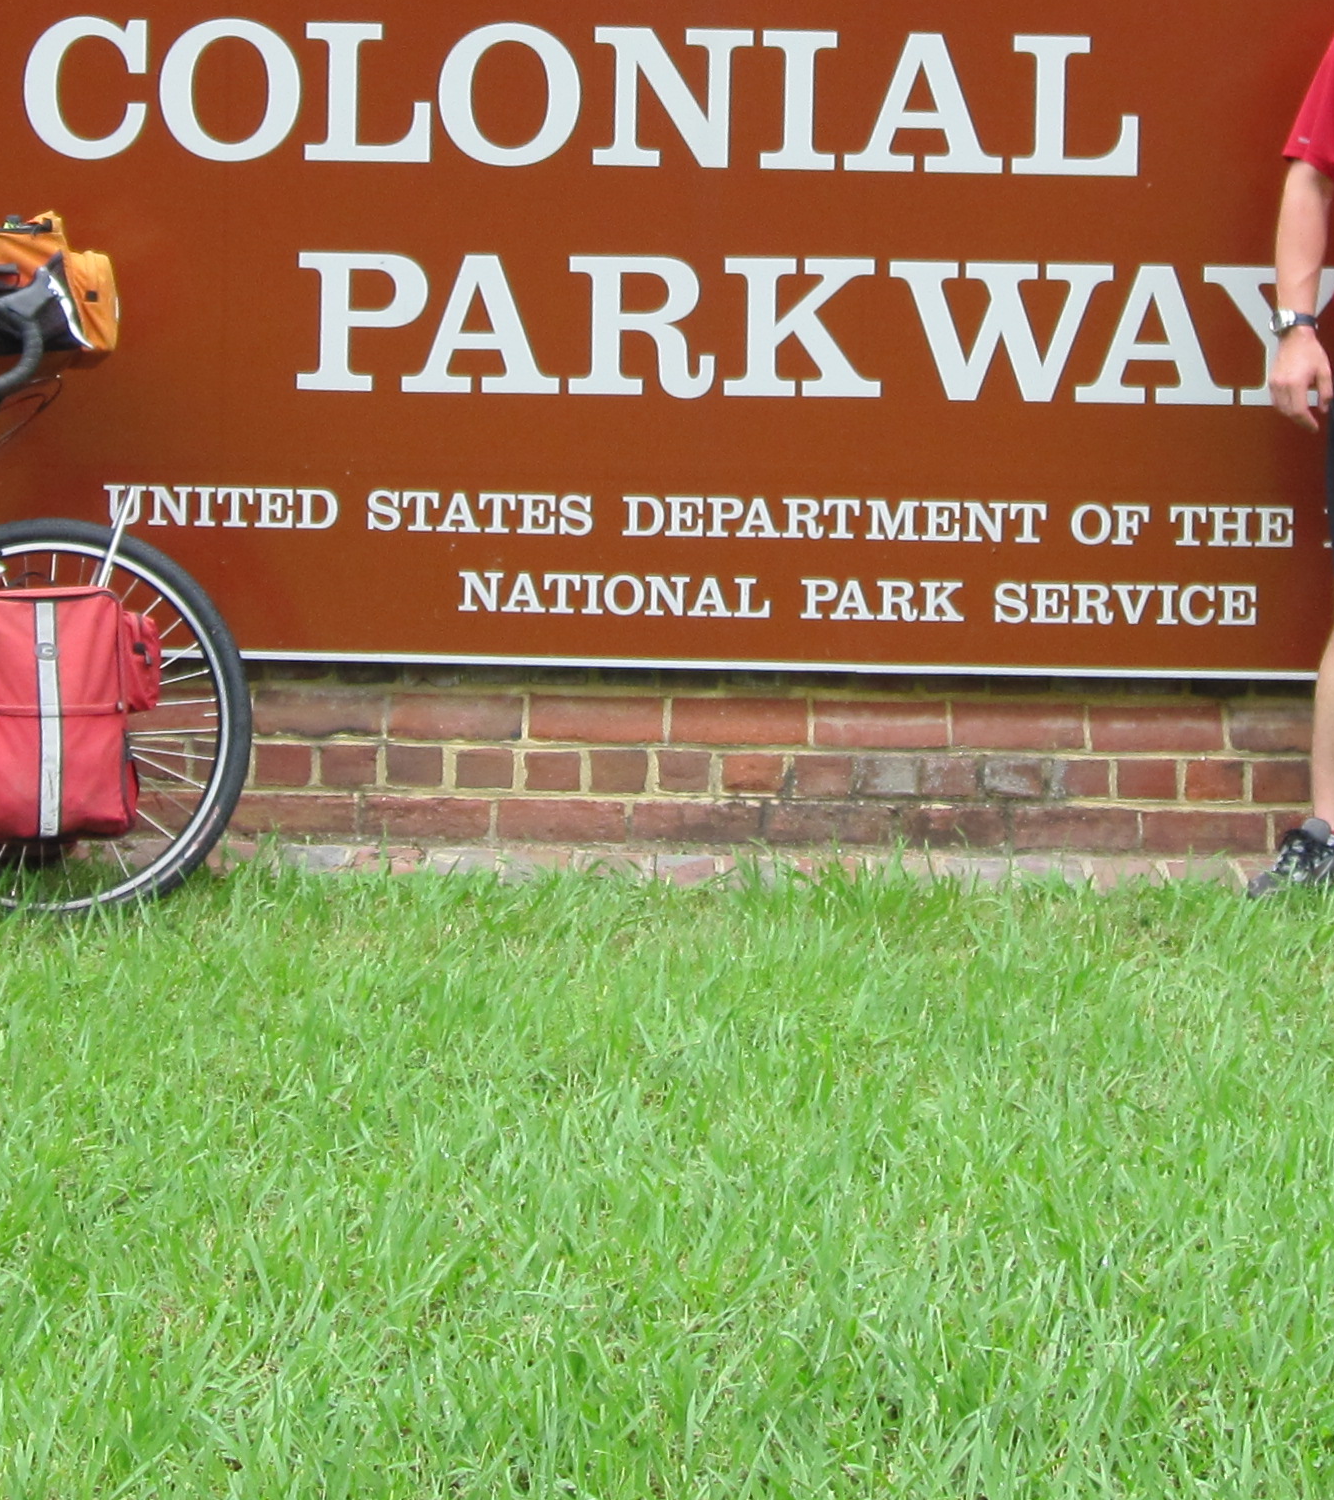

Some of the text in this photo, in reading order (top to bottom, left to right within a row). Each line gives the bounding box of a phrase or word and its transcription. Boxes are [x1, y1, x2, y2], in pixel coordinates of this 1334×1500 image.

[23, 15, 1140, 177] COLONIAL
[103, 484, 339, 530] UNITED
[367, 489, 594, 536] STATES
[621, 495, 1048, 544] DEPARTMENT
[1070, 503, 1151, 546] OF
[1169, 505, 1294, 548] THE
[457, 570, 1257, 627] NATIONAL PARK SERVICE
